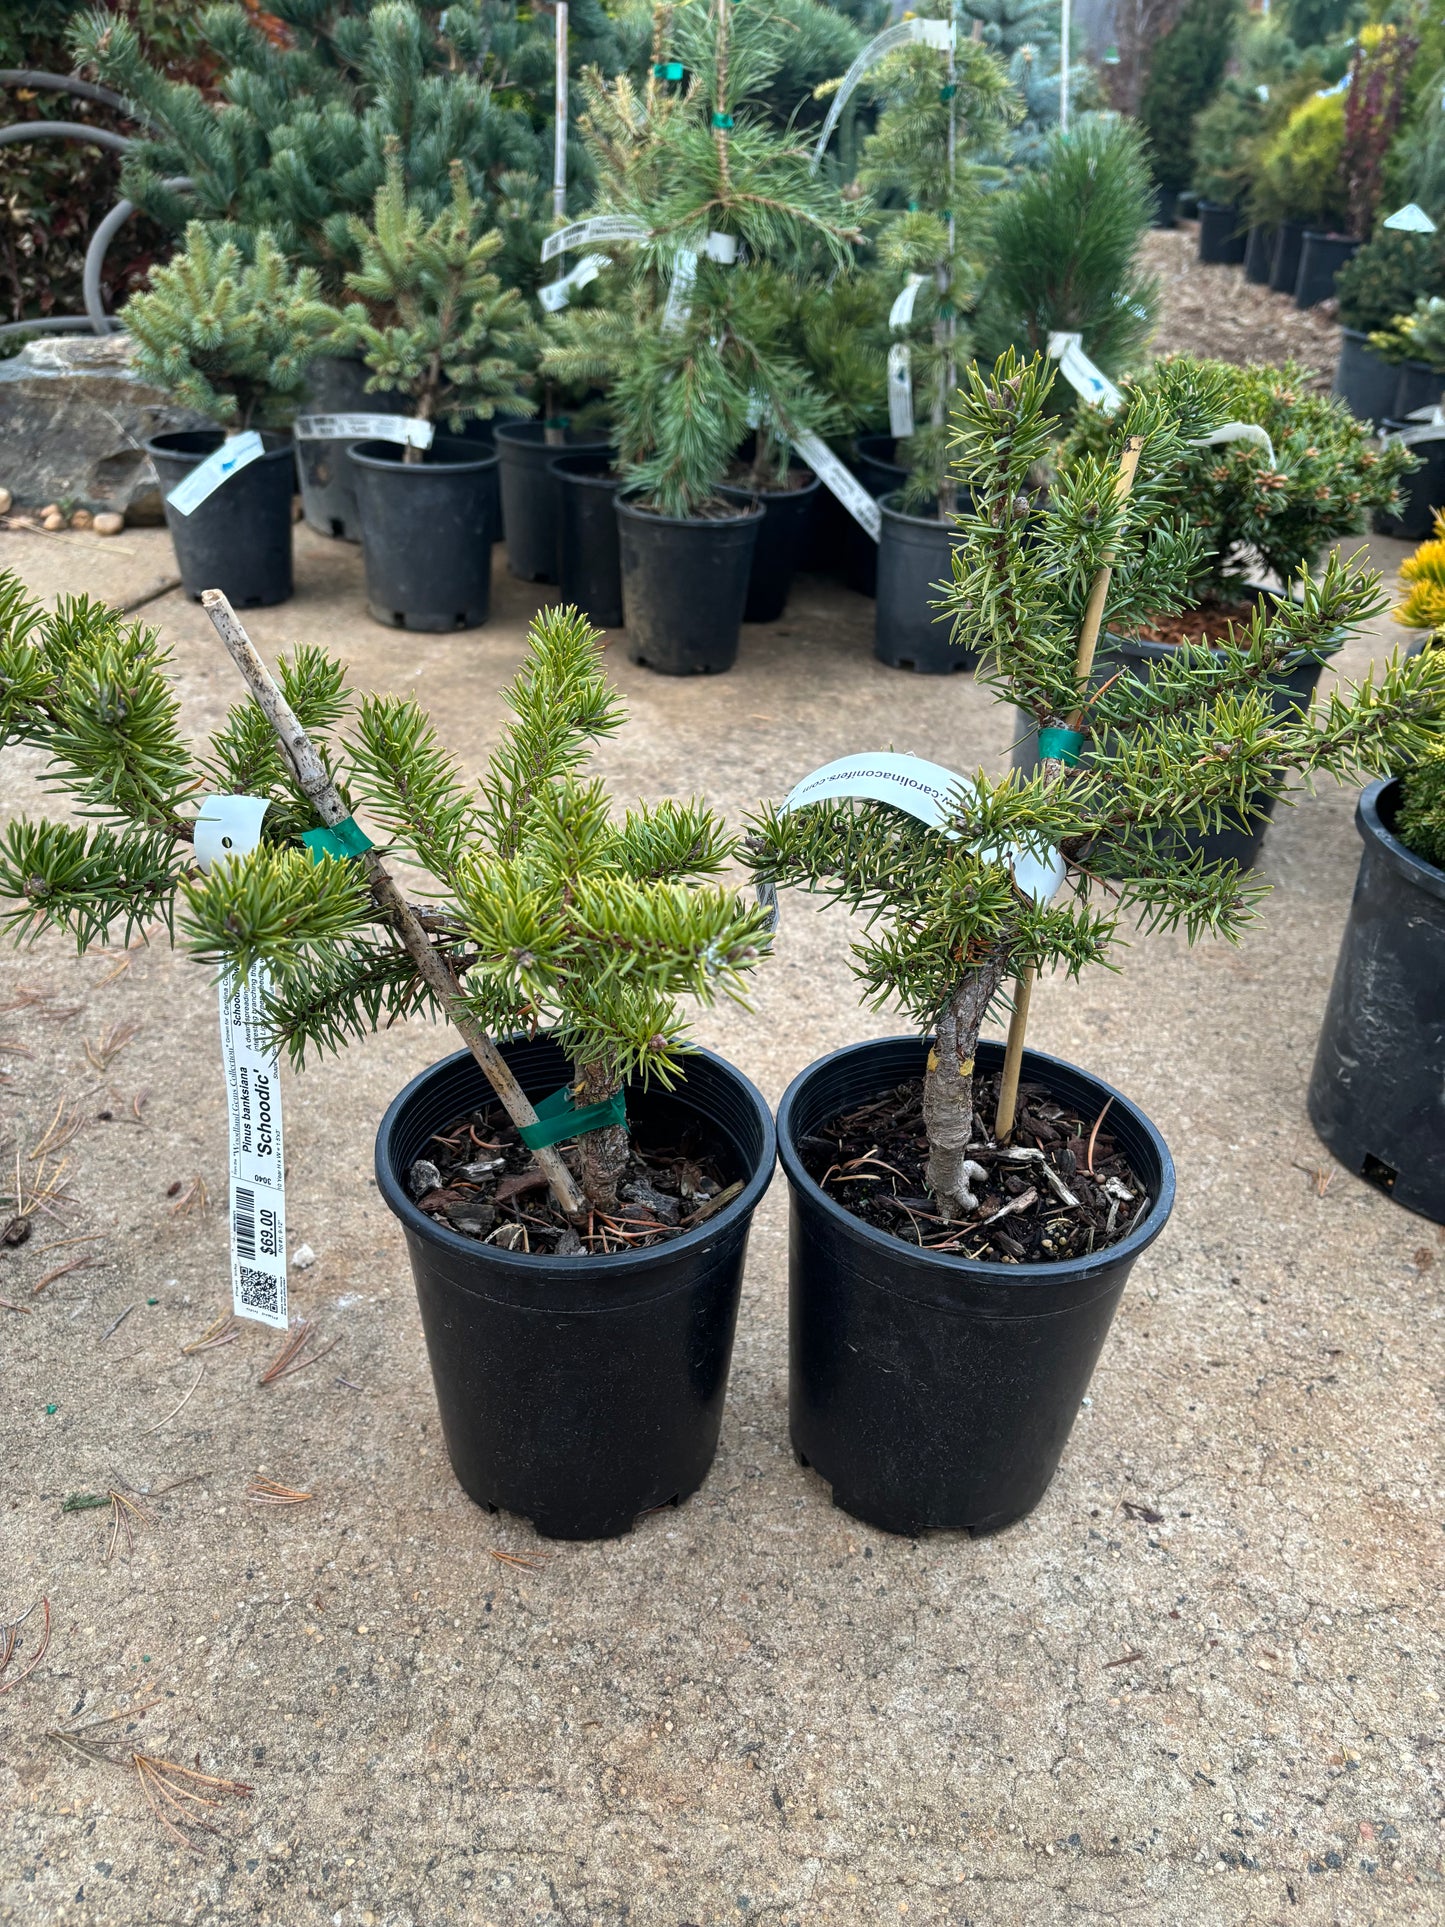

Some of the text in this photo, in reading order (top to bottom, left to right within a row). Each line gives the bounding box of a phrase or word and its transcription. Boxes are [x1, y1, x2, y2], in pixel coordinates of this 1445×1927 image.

[240, 1067, 252, 1153] Pinus banksiana
[253, 1069, 272, 1157] 'Schoodic'
[254, 1174, 271, 1185] 3040
[260, 1209, 275, 1255] $69.00
